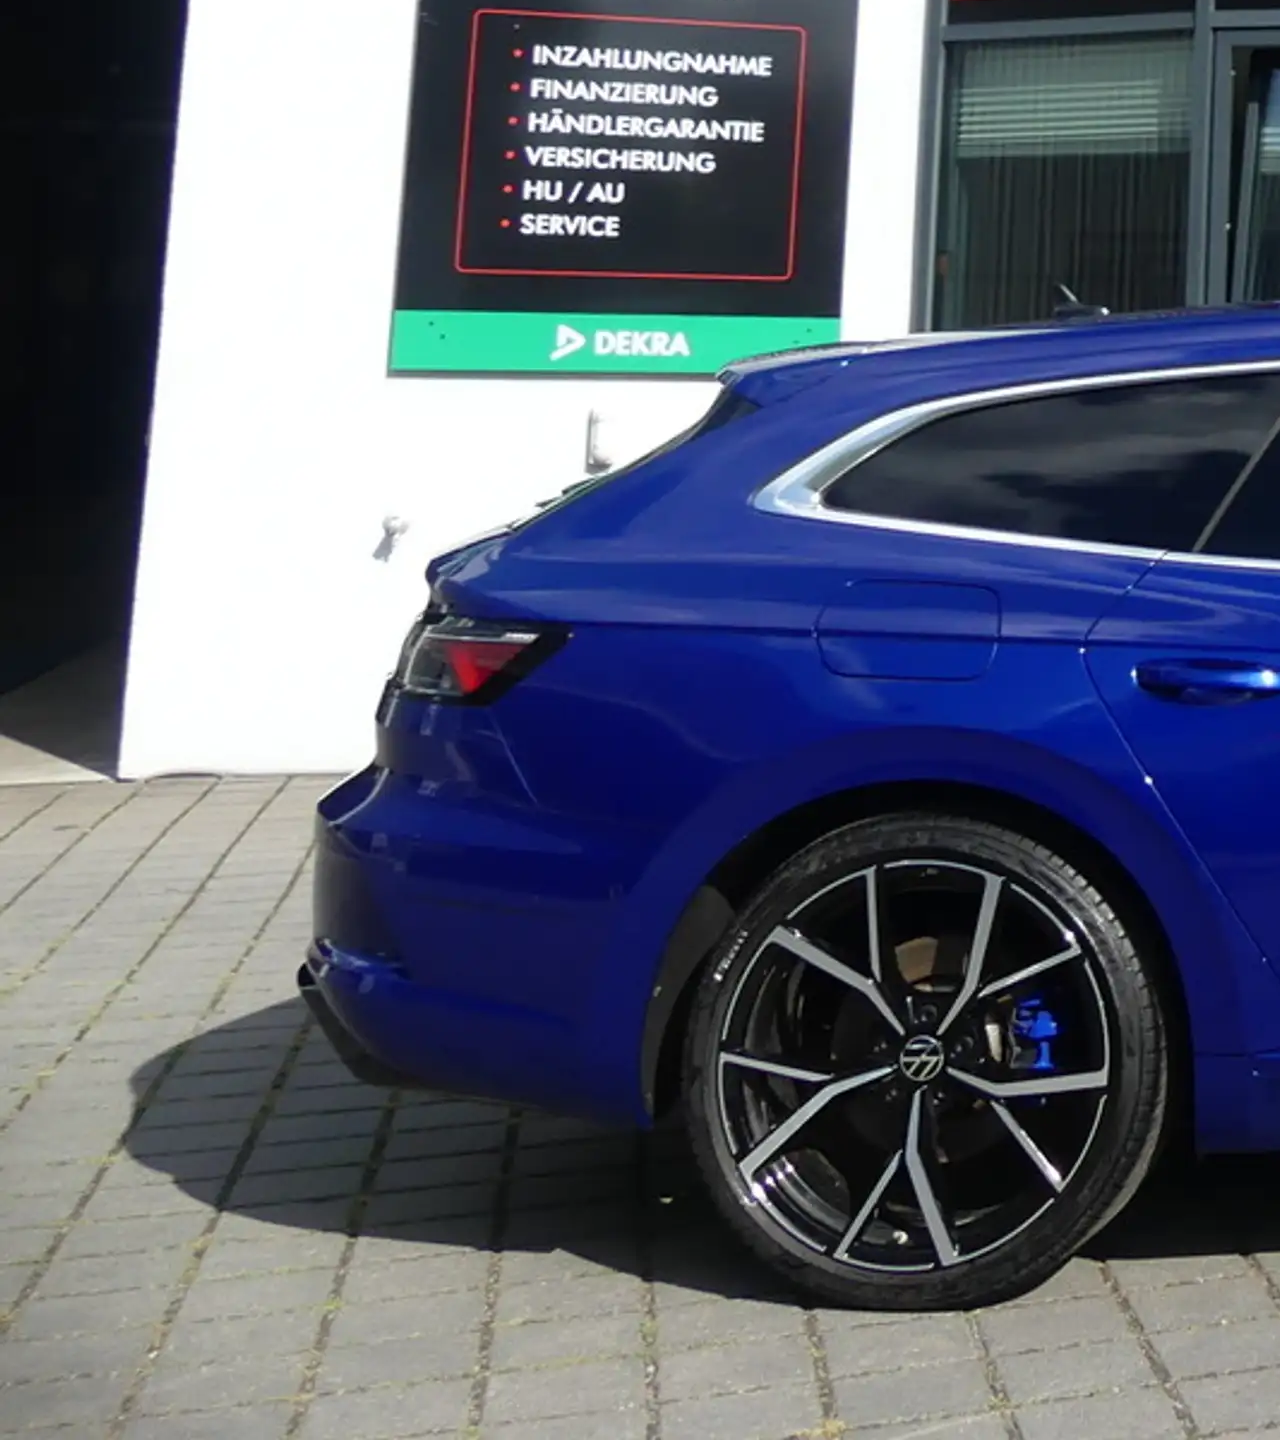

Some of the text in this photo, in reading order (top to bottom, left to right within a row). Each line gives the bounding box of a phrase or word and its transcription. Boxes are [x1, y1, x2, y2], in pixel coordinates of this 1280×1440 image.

[531, 44, 773, 77] INZAHLUNGNAHME
[529, 78, 719, 108] FINANZIERUNG
[527, 110, 765, 143] HÄNDLERGARANTIE
[524, 145, 717, 174] VERSICHERUNG
[522, 179, 625, 204] HU / AU
[519, 213, 620, 238] SERVICE
[594, 330, 691, 358] DEKRA
